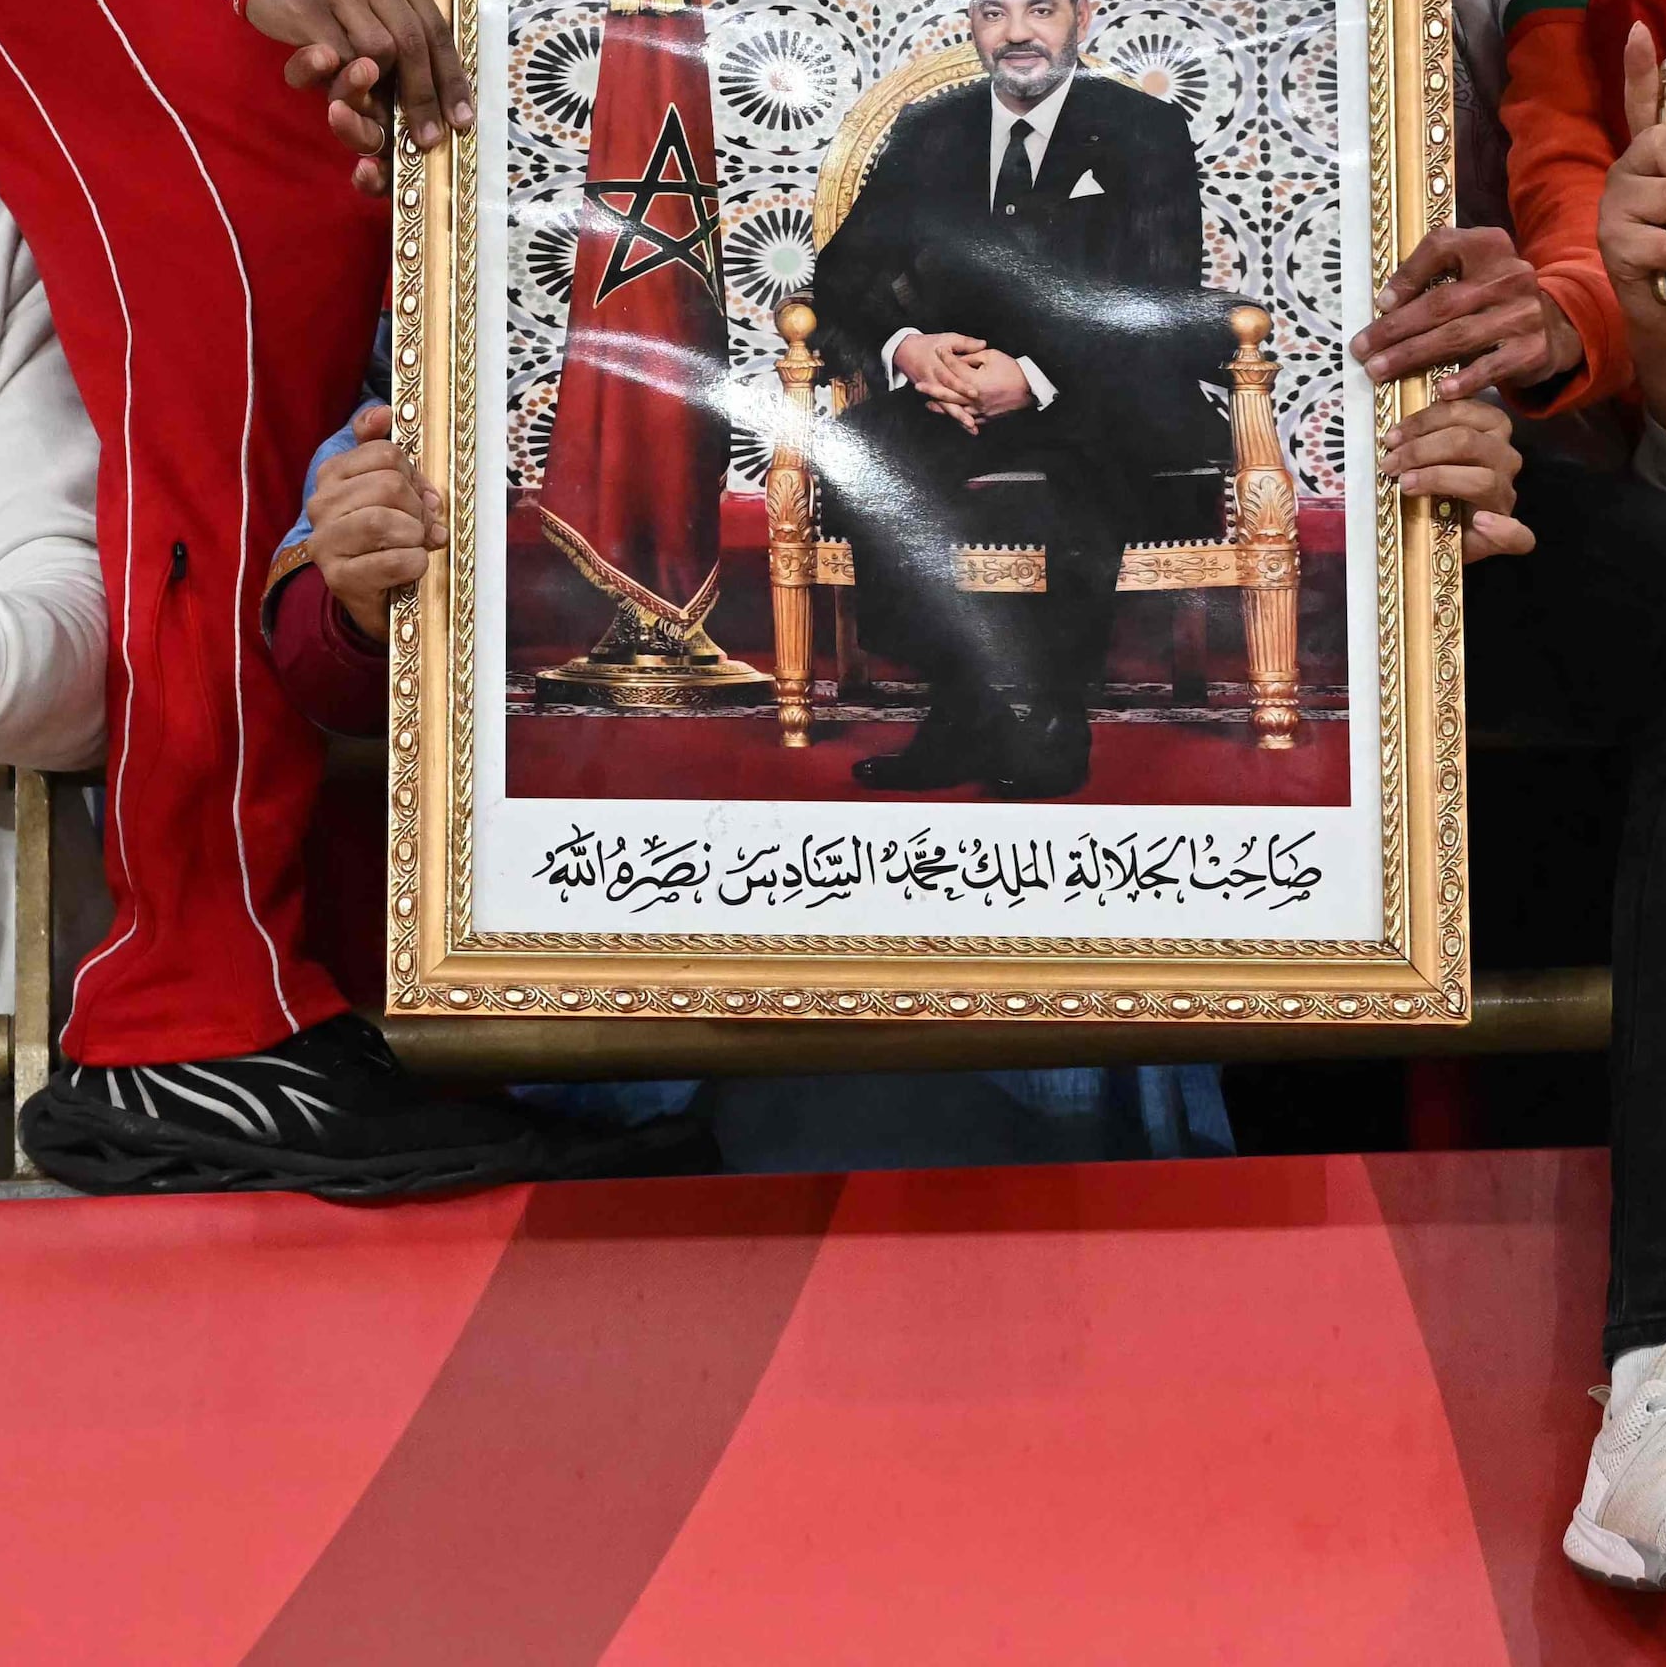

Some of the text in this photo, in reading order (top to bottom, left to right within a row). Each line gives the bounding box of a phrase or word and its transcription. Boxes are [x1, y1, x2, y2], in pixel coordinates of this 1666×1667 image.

[532, 823, 606, 903] الله
[718, 834, 875, 908] السادس
[880, 827, 964, 901] محمد
[959, 838, 1055, 908] الملك
